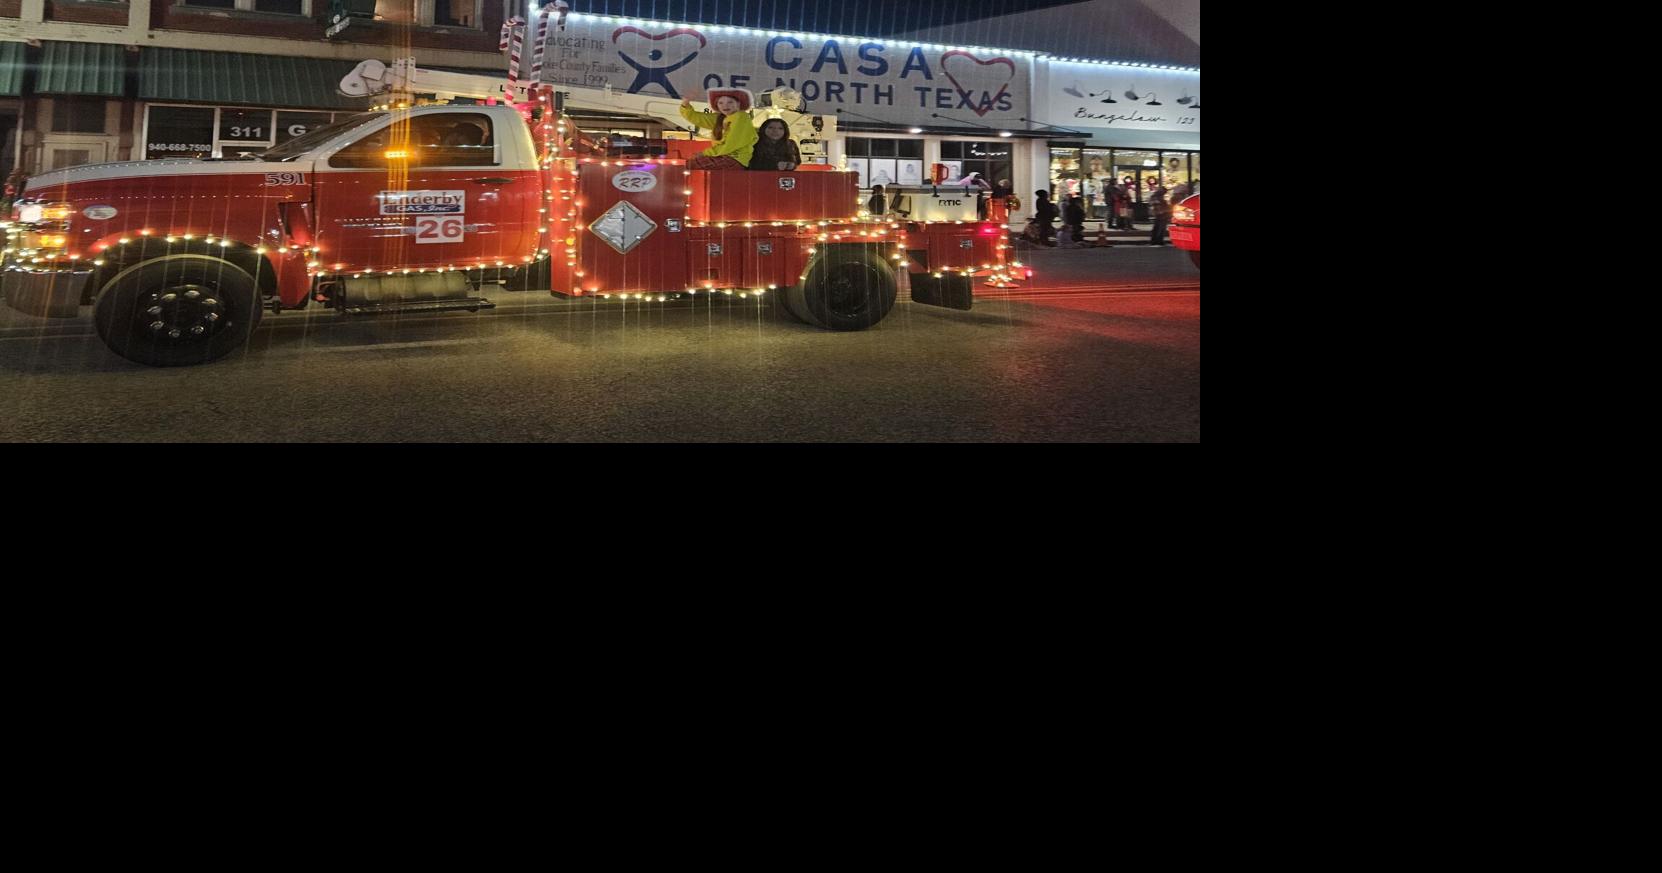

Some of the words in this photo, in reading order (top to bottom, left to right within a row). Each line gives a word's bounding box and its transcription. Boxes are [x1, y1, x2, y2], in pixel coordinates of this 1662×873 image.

[545, 32, 605, 50] dvocating
[765, 35, 933, 80] CASA
[914, 86, 1012, 111] TEXAS
[230, 126, 262, 137] 311
[149, 143, 211, 152] 940-668-7500
[265, 172, 306, 186] 591
[418, 219, 462, 239] 26
